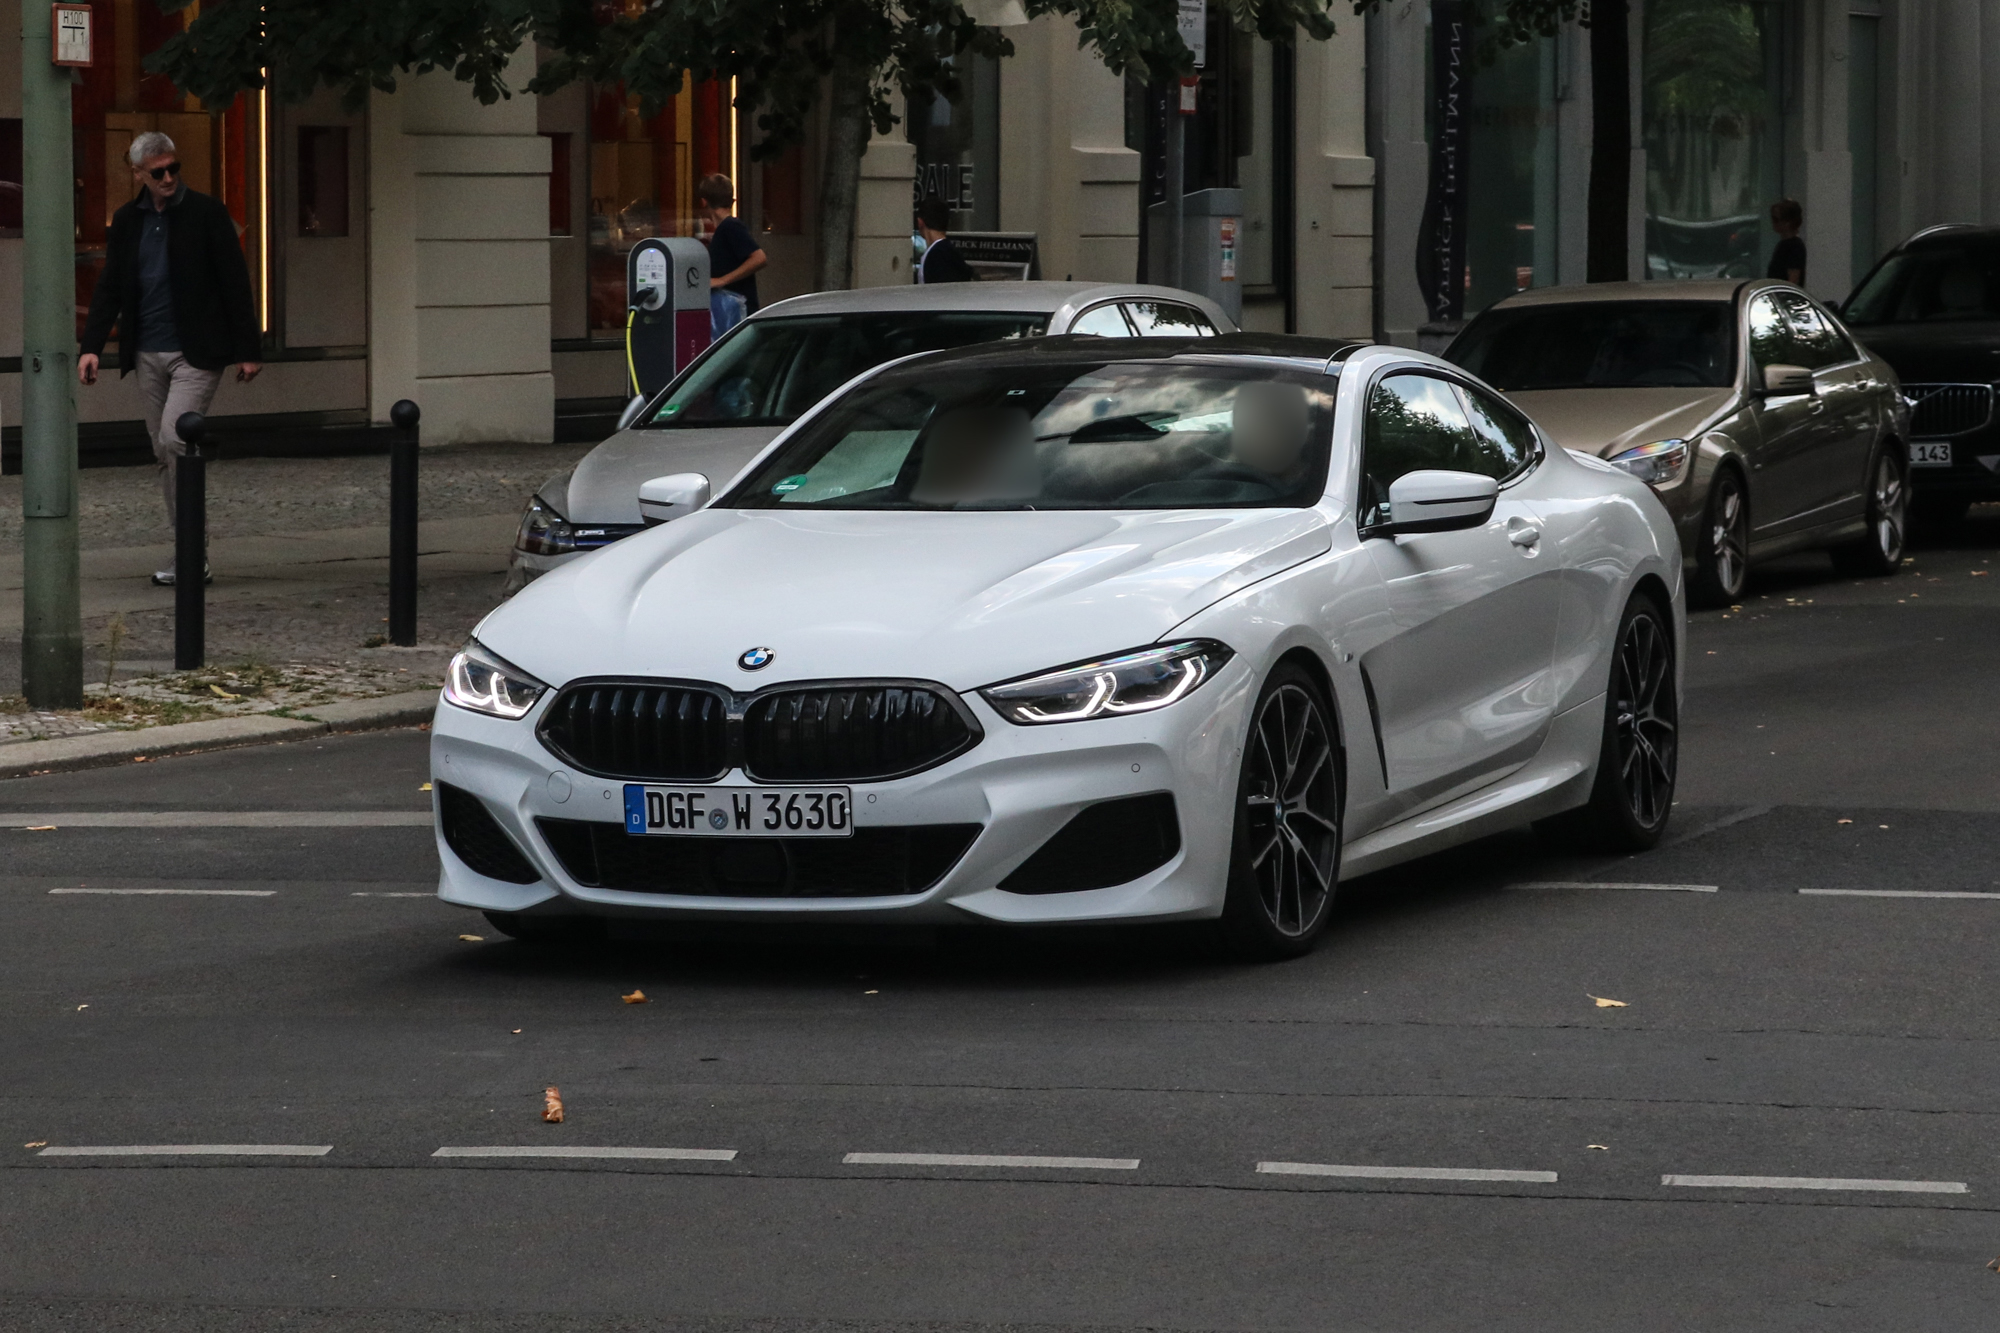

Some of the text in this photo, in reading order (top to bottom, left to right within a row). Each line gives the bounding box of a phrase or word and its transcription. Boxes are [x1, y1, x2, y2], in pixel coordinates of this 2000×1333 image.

[64, 11, 83, 25] H100
[950, 240, 1032, 251] TRICK HELLMANN
[1918, 445, 1949, 461] 143
[646, 791, 846, 831] DGF W 3630
[632, 813, 641, 825] D
